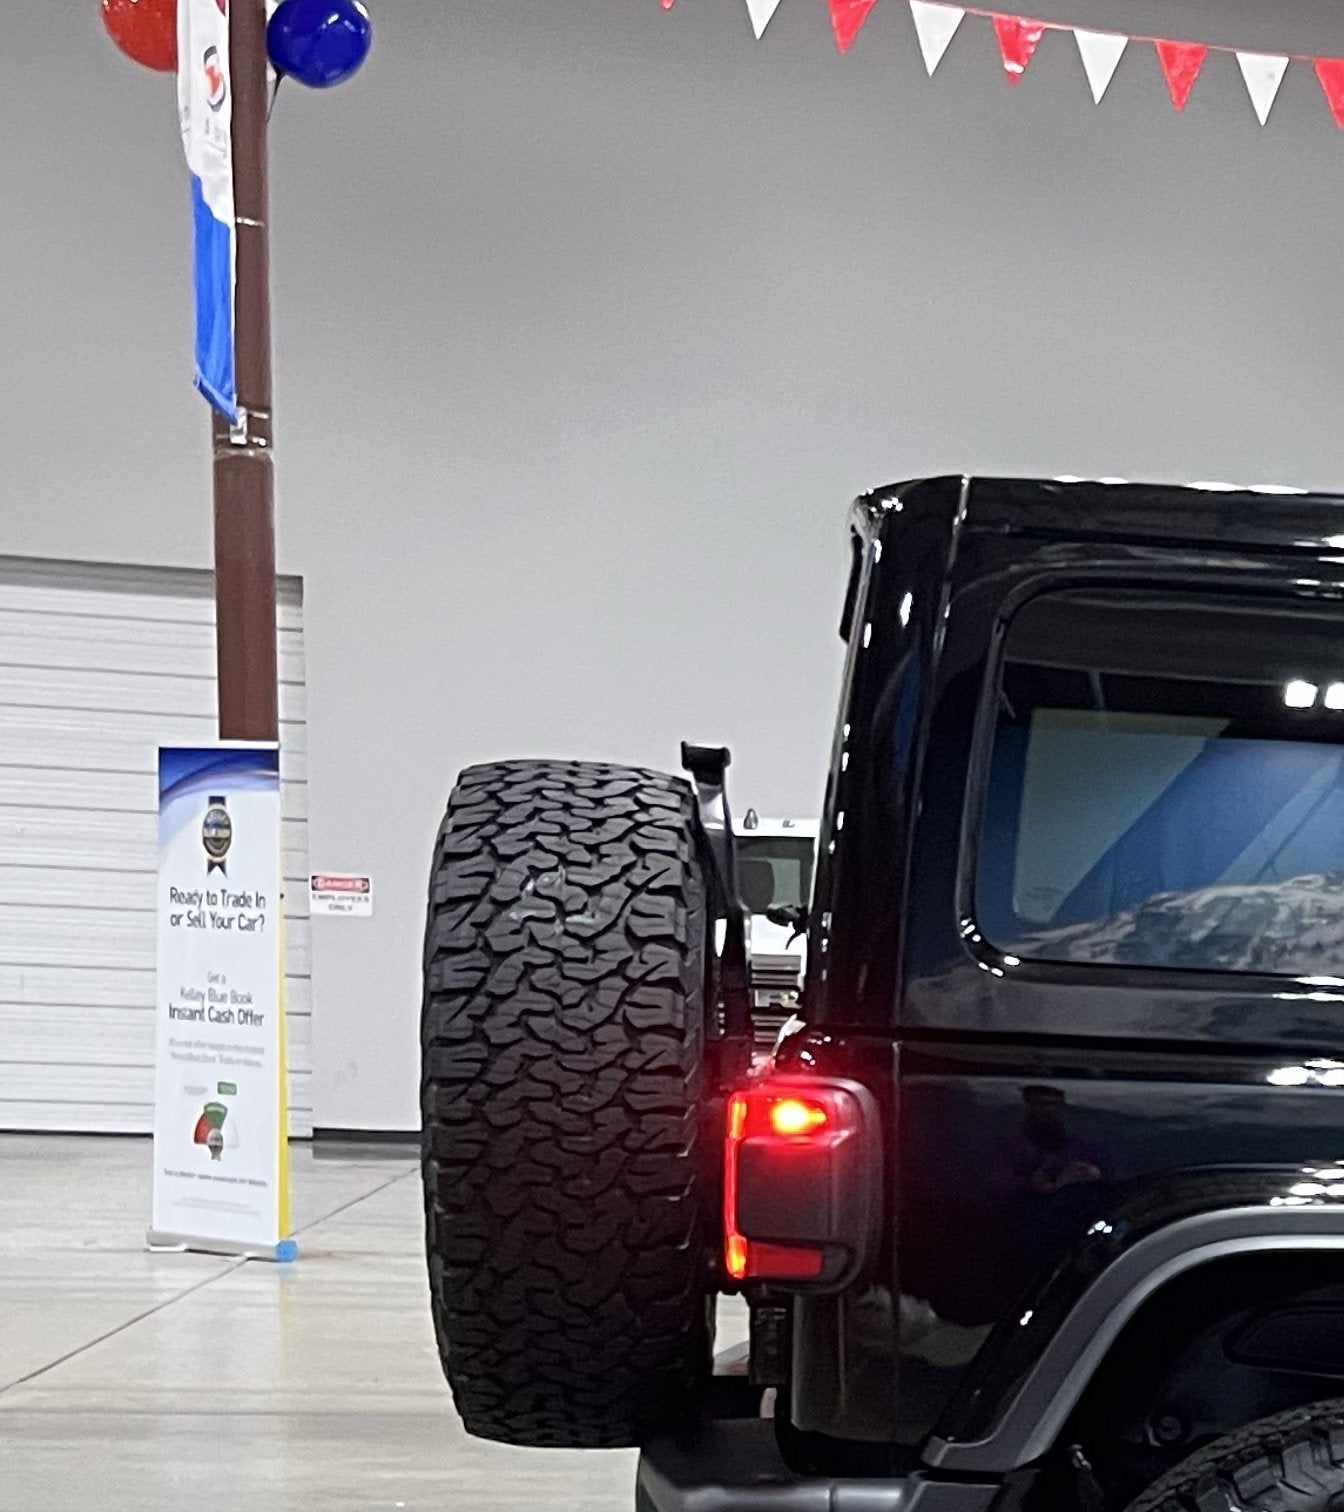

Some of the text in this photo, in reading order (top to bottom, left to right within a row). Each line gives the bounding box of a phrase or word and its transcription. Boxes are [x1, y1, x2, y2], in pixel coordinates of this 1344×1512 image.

[169, 886, 266, 909] Ready to Trade In
[169, 910, 265, 932] or Sell Your Car?
[207, 1006, 235, 1024] Cash
